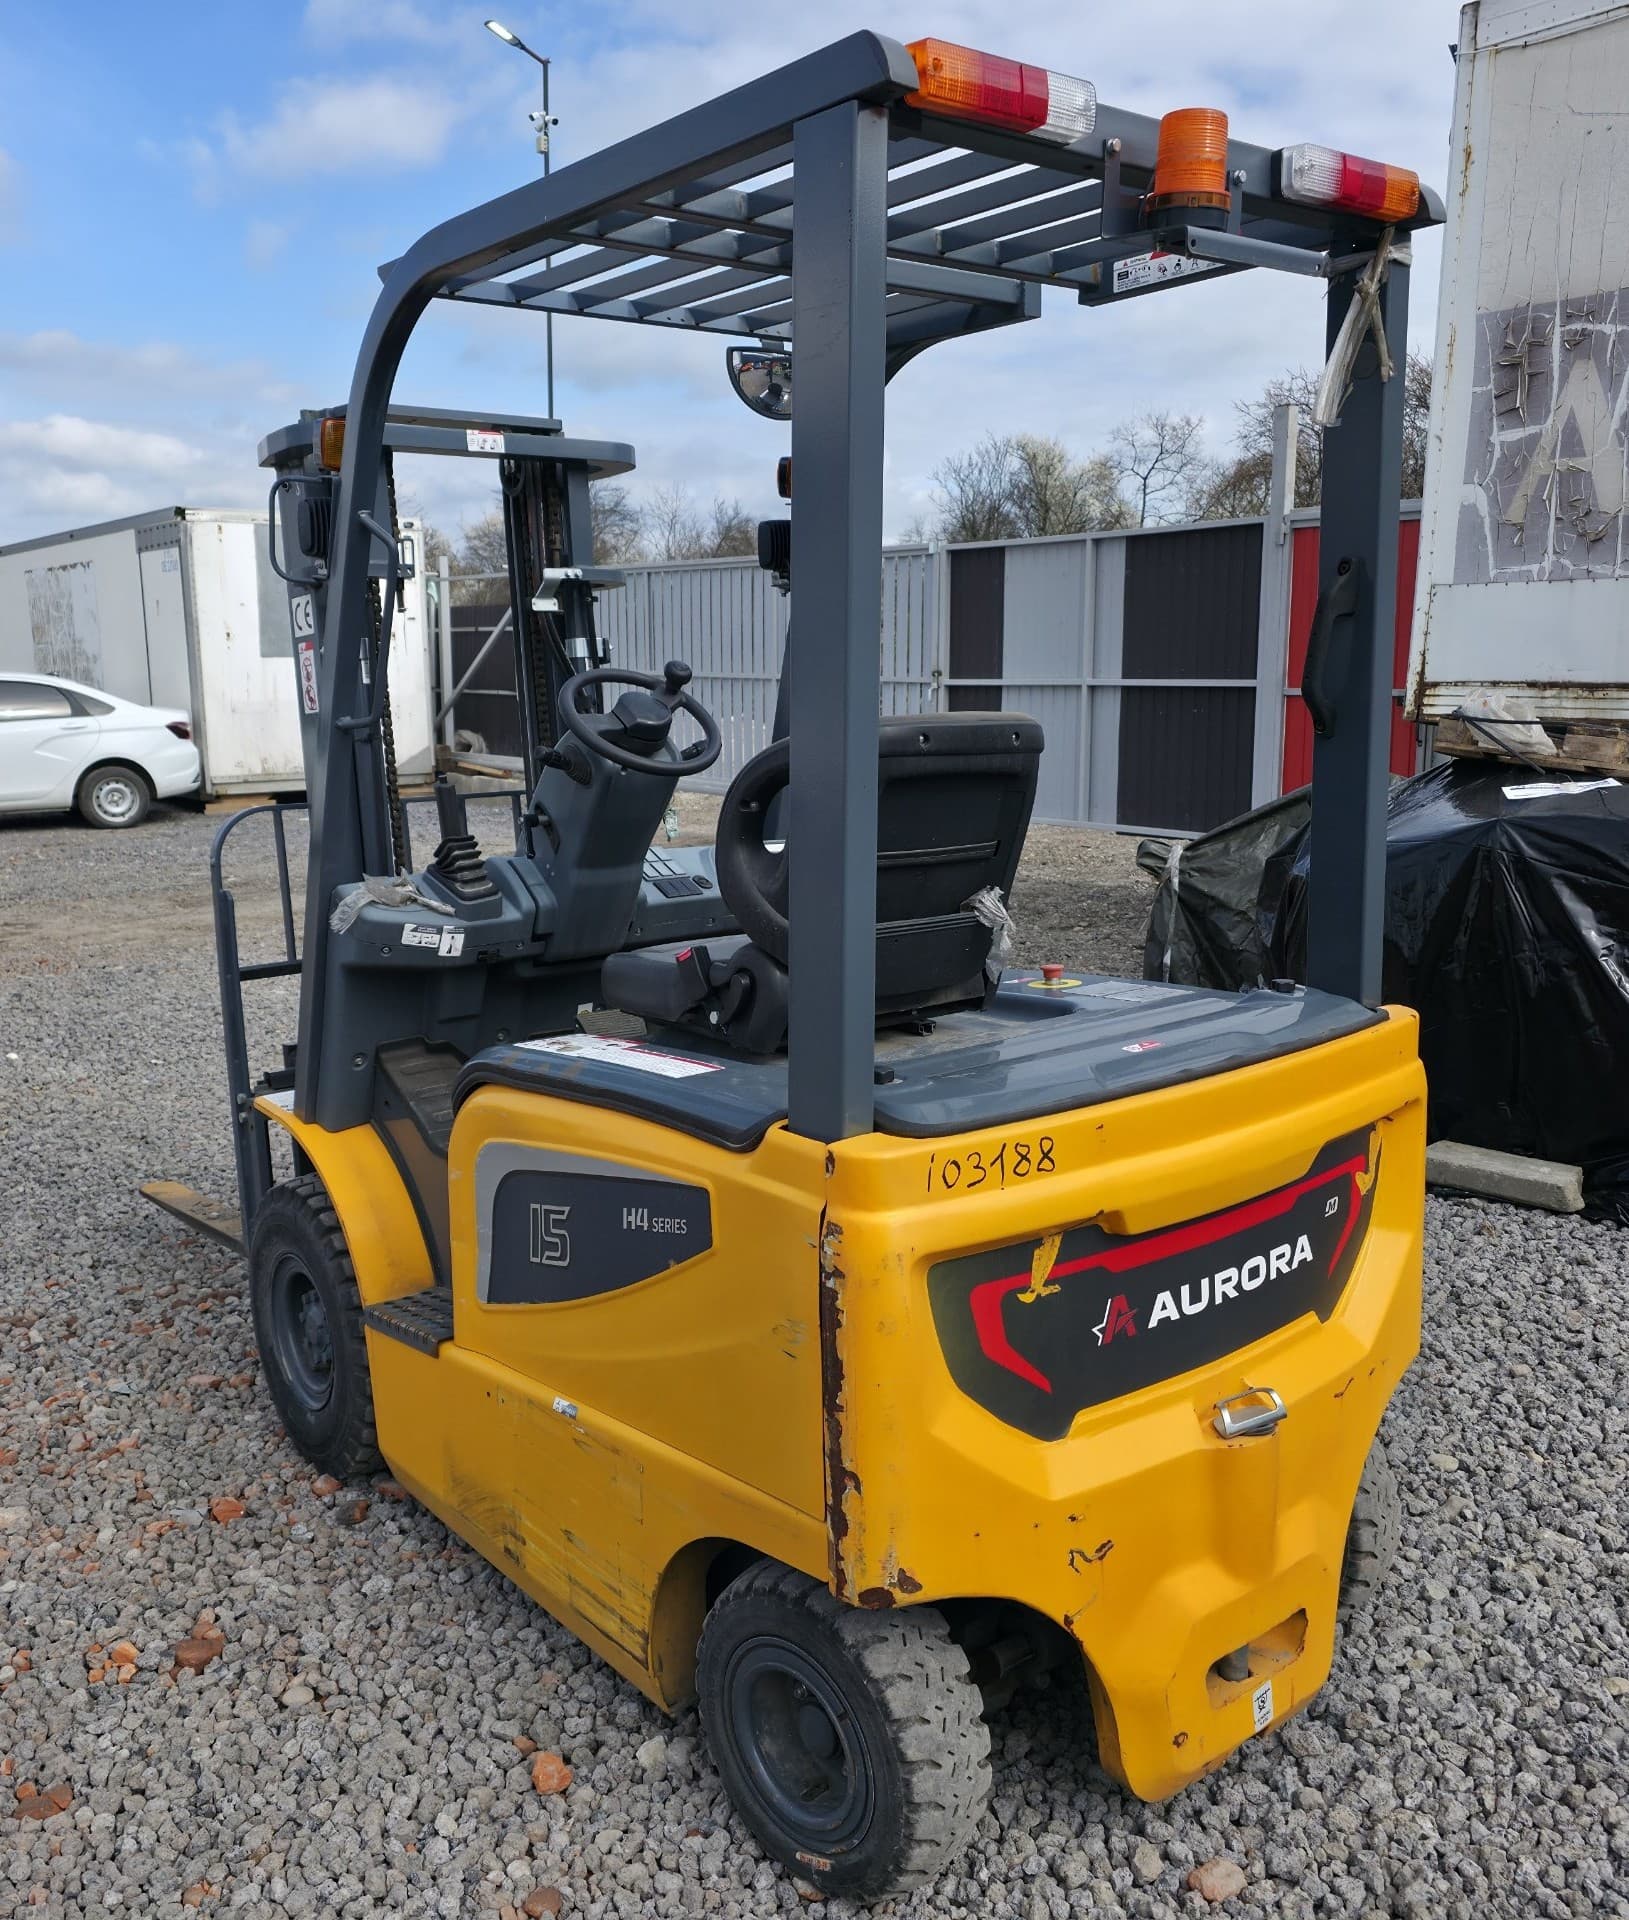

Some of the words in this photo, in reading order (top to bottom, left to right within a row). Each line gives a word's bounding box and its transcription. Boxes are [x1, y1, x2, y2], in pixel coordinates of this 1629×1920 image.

[530, 1203, 571, 1267] 15
[622, 1207, 649, 1231] H4
[652, 1217, 687, 1234] SERIES
[1147, 1234, 1314, 1329] AURORA
